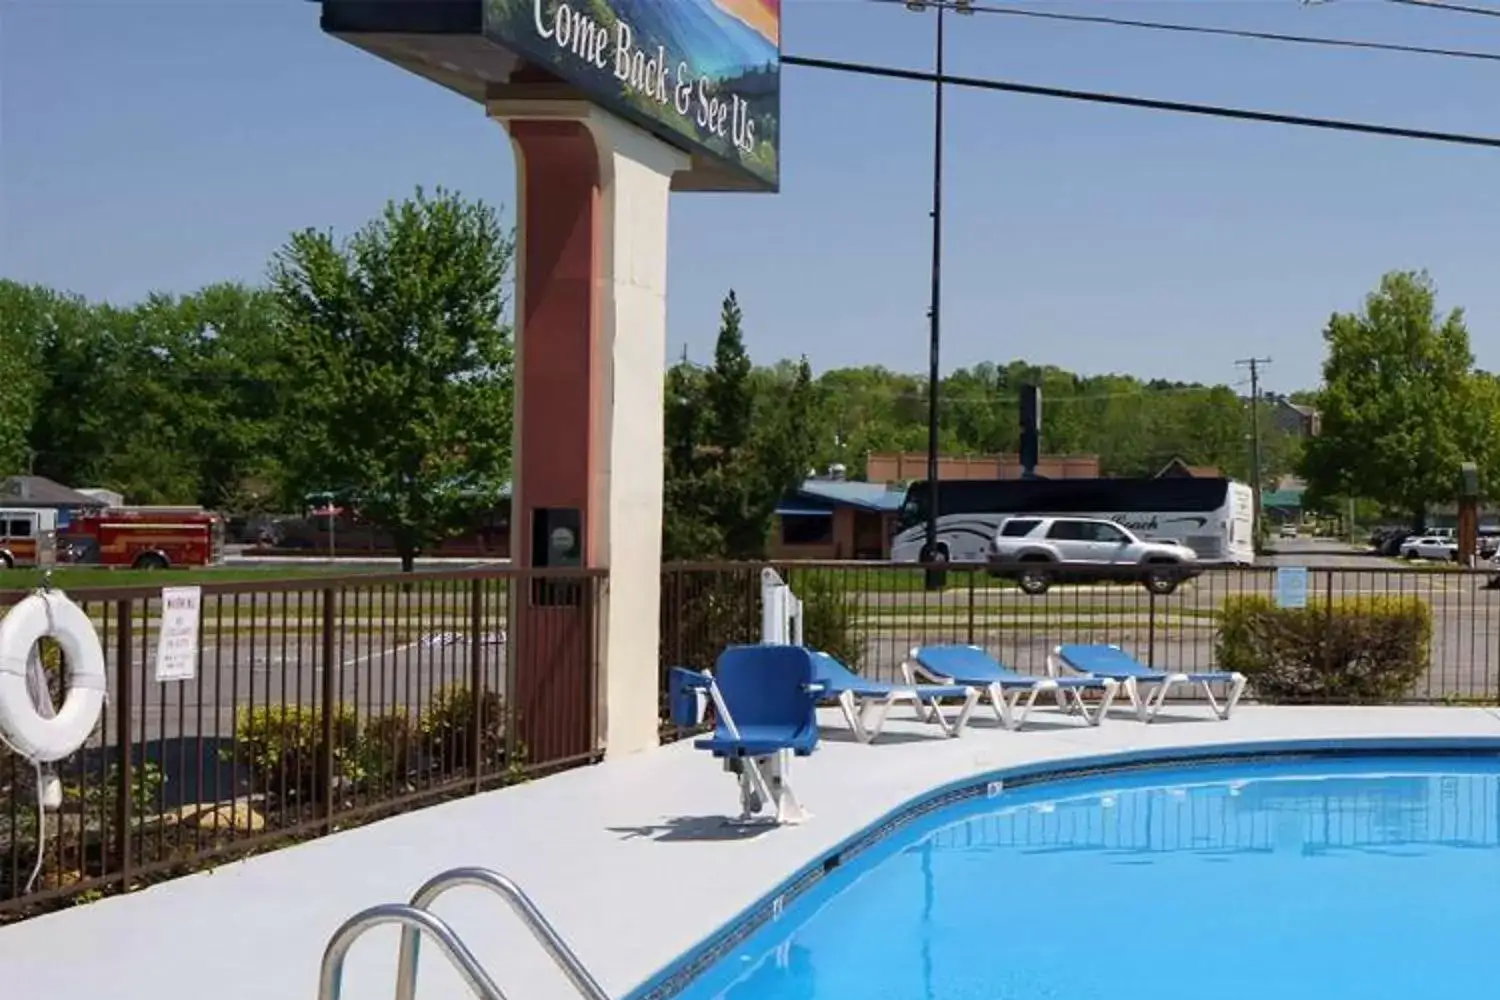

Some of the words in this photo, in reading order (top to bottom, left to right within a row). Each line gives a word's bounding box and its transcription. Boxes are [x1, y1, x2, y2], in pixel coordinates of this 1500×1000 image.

[534, 0, 608, 68] Come
[613, 19, 668, 104] Back
[675, 61, 693, 115] &
[697, 75, 729, 137] See
[732, 94, 756, 153] Us
